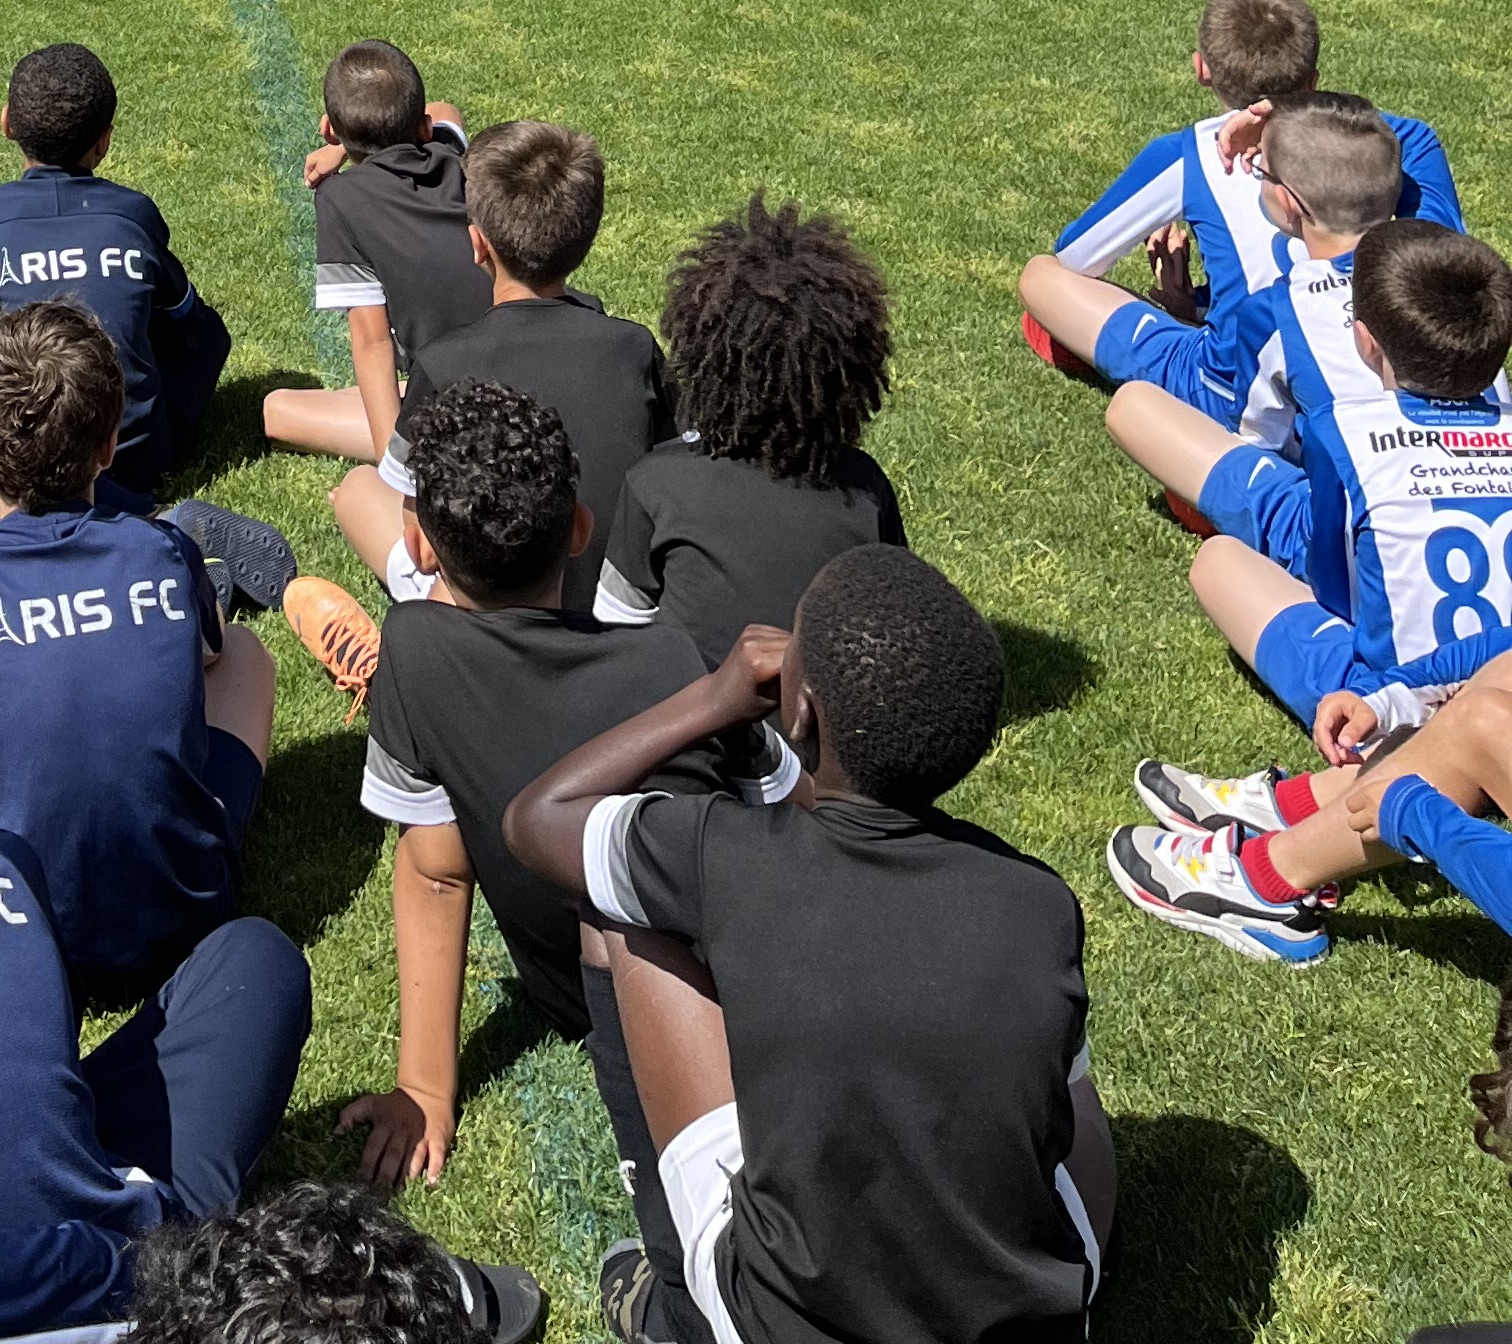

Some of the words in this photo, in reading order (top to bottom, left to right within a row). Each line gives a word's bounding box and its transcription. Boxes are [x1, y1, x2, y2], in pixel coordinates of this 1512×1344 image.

[100, 247, 144, 280] FC
[1409, 461, 1512, 478] Grandcha
[1408, 481, 1444, 497] des
[129, 578, 186, 626] FC
